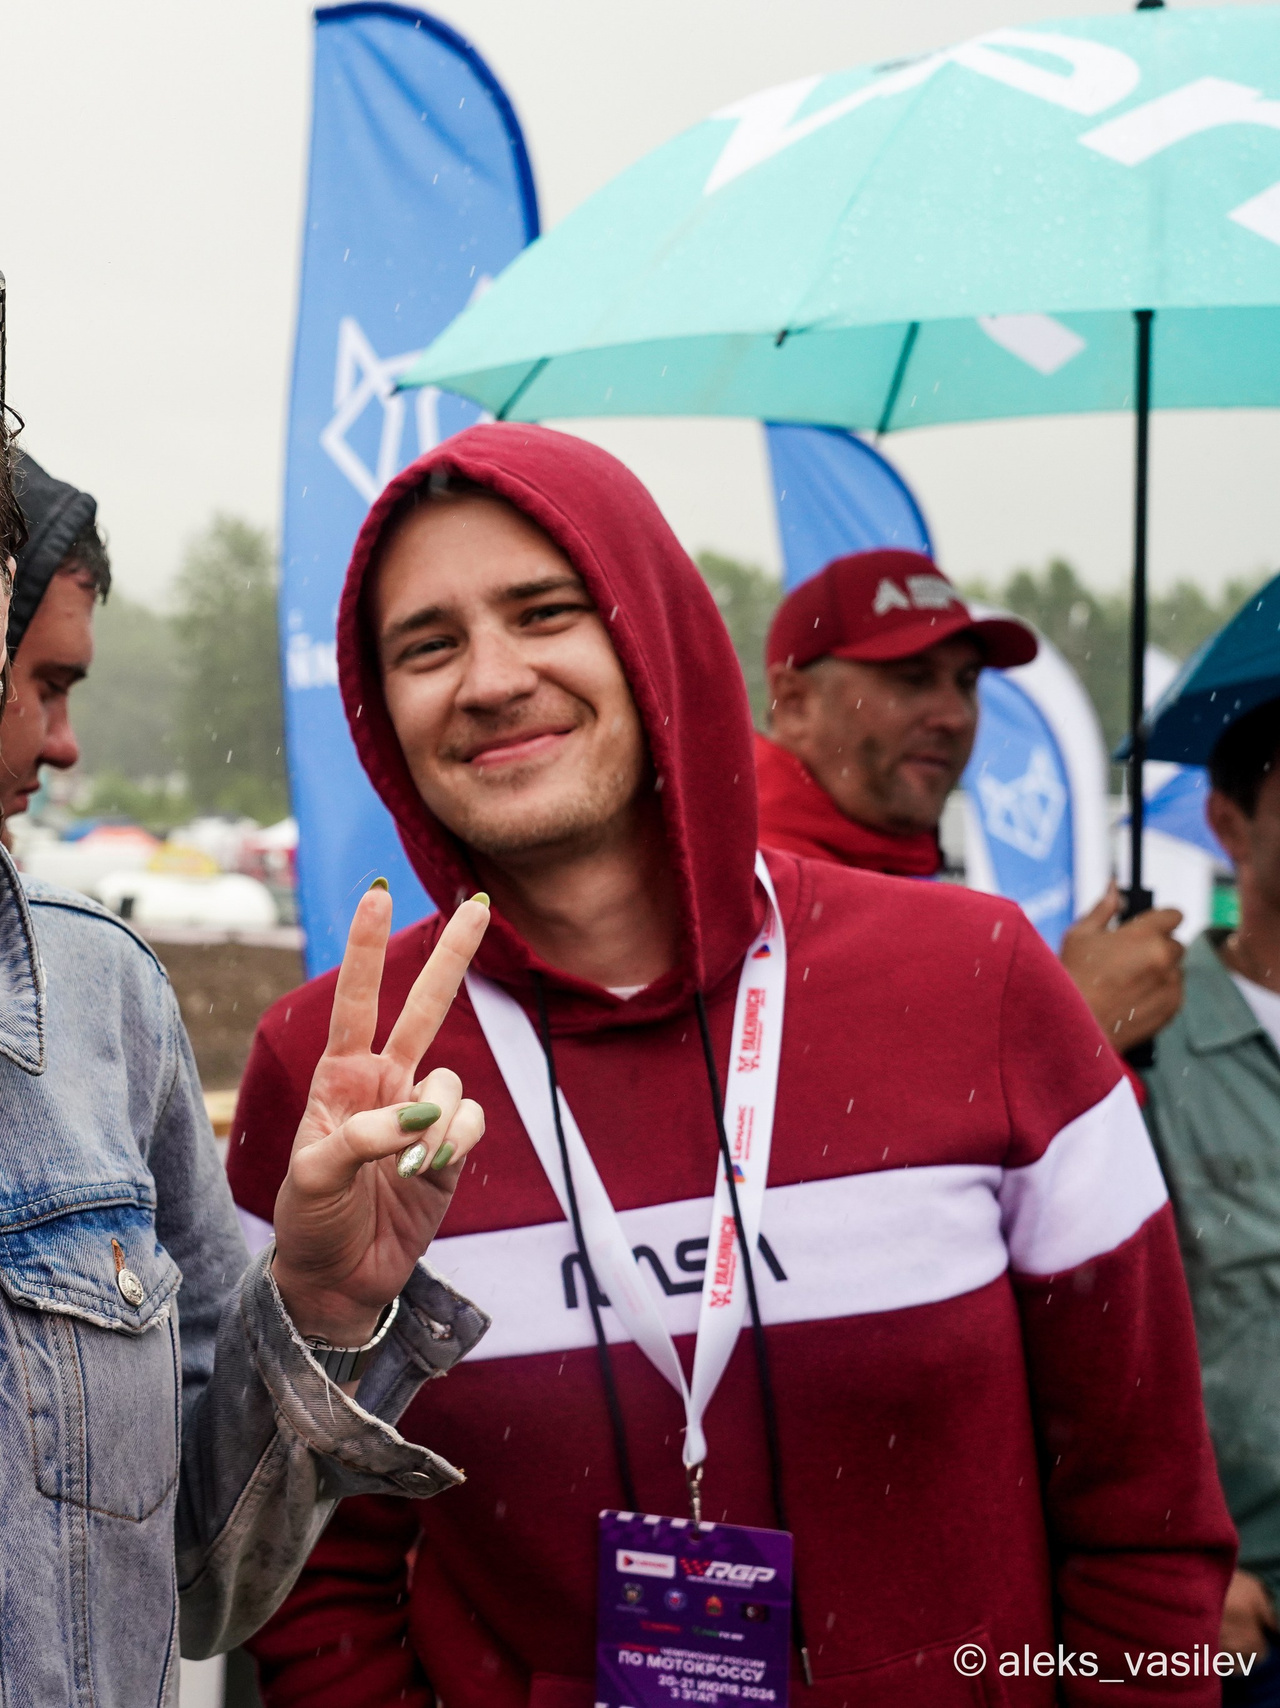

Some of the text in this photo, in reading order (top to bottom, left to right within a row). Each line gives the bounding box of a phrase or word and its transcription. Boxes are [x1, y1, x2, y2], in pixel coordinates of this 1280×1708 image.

[618, 1650, 765, 1683] ПО МОТОКРОССУ
[658, 1673, 777, 1701] 20-21 ИЮЛЯ 2024
[681, 1689, 719, 1704] ЭТАП
